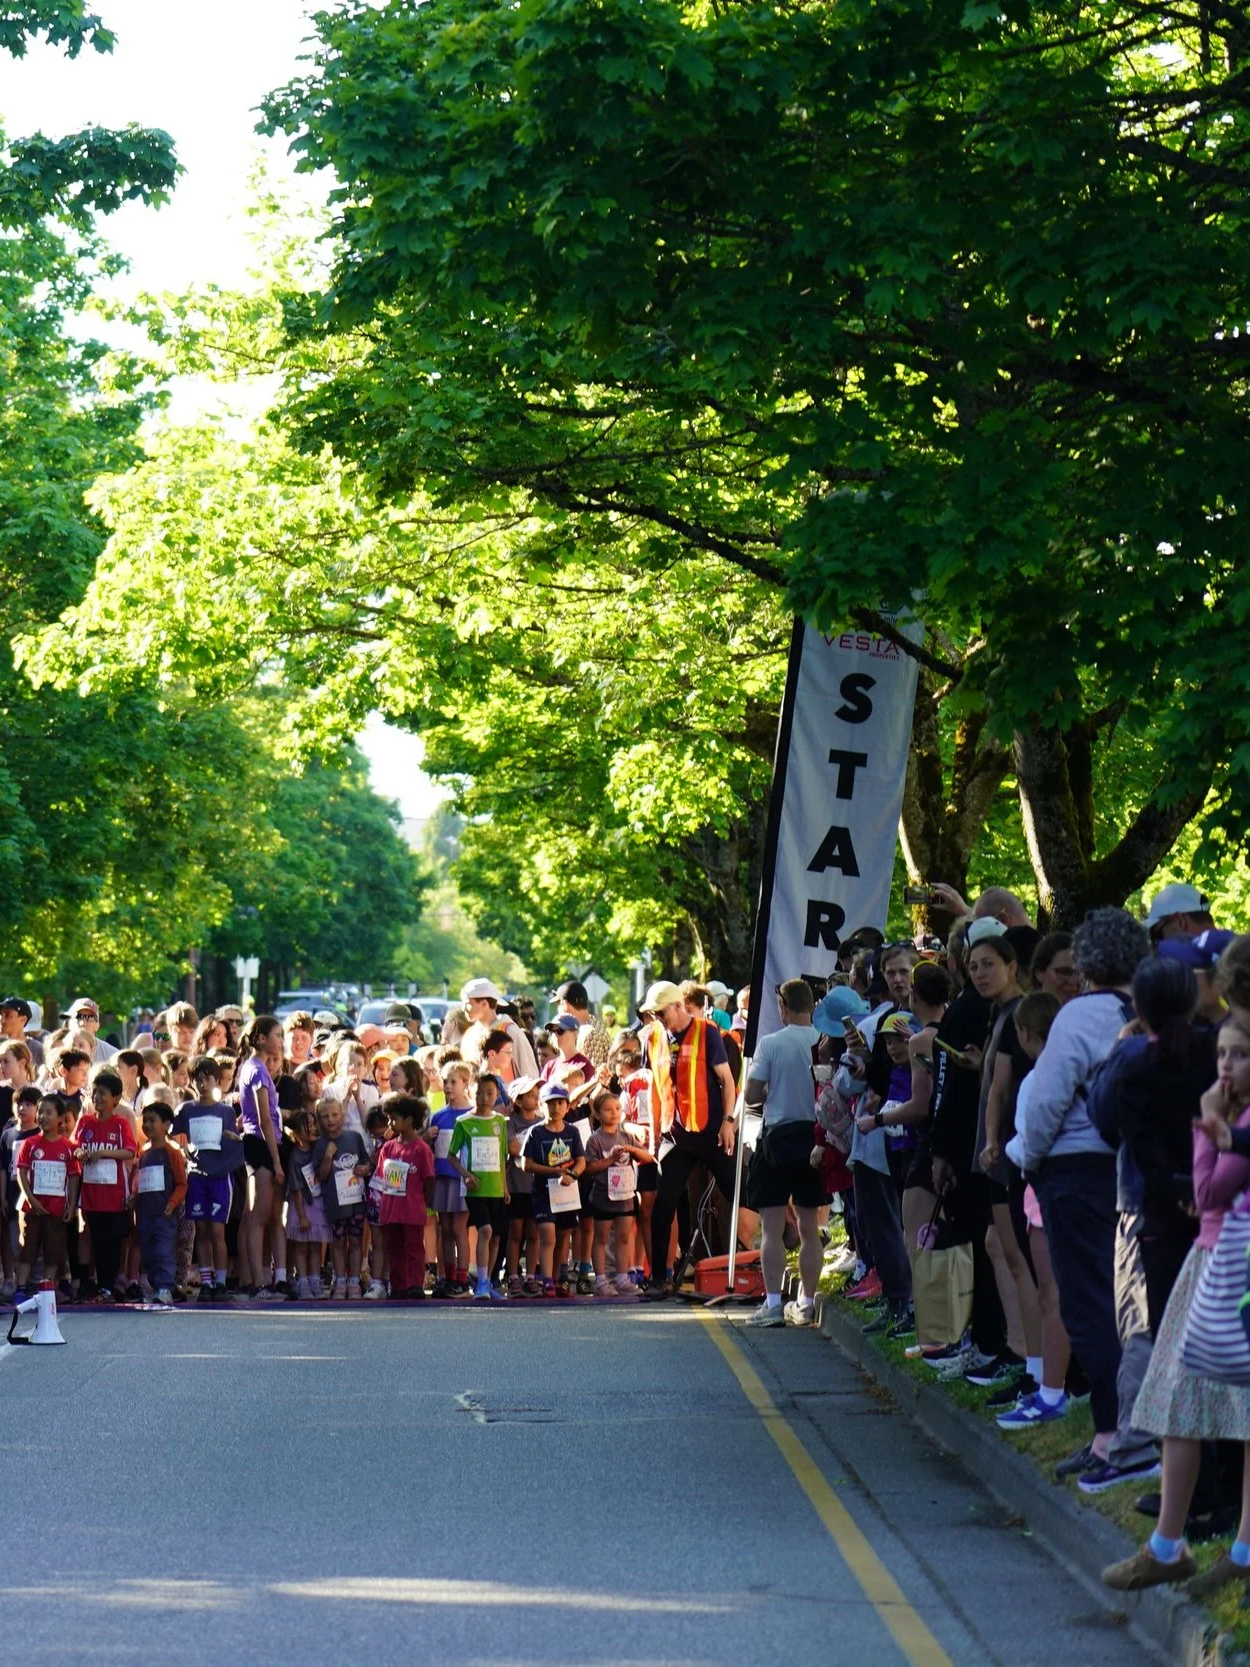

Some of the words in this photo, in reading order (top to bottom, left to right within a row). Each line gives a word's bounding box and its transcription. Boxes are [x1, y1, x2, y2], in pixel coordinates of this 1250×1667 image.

[823, 633, 900, 655] VESTA
[801, 673, 878, 983] STAR
[81, 1142, 118, 1153] CANADA
[211, 1202, 221, 1216] 7
